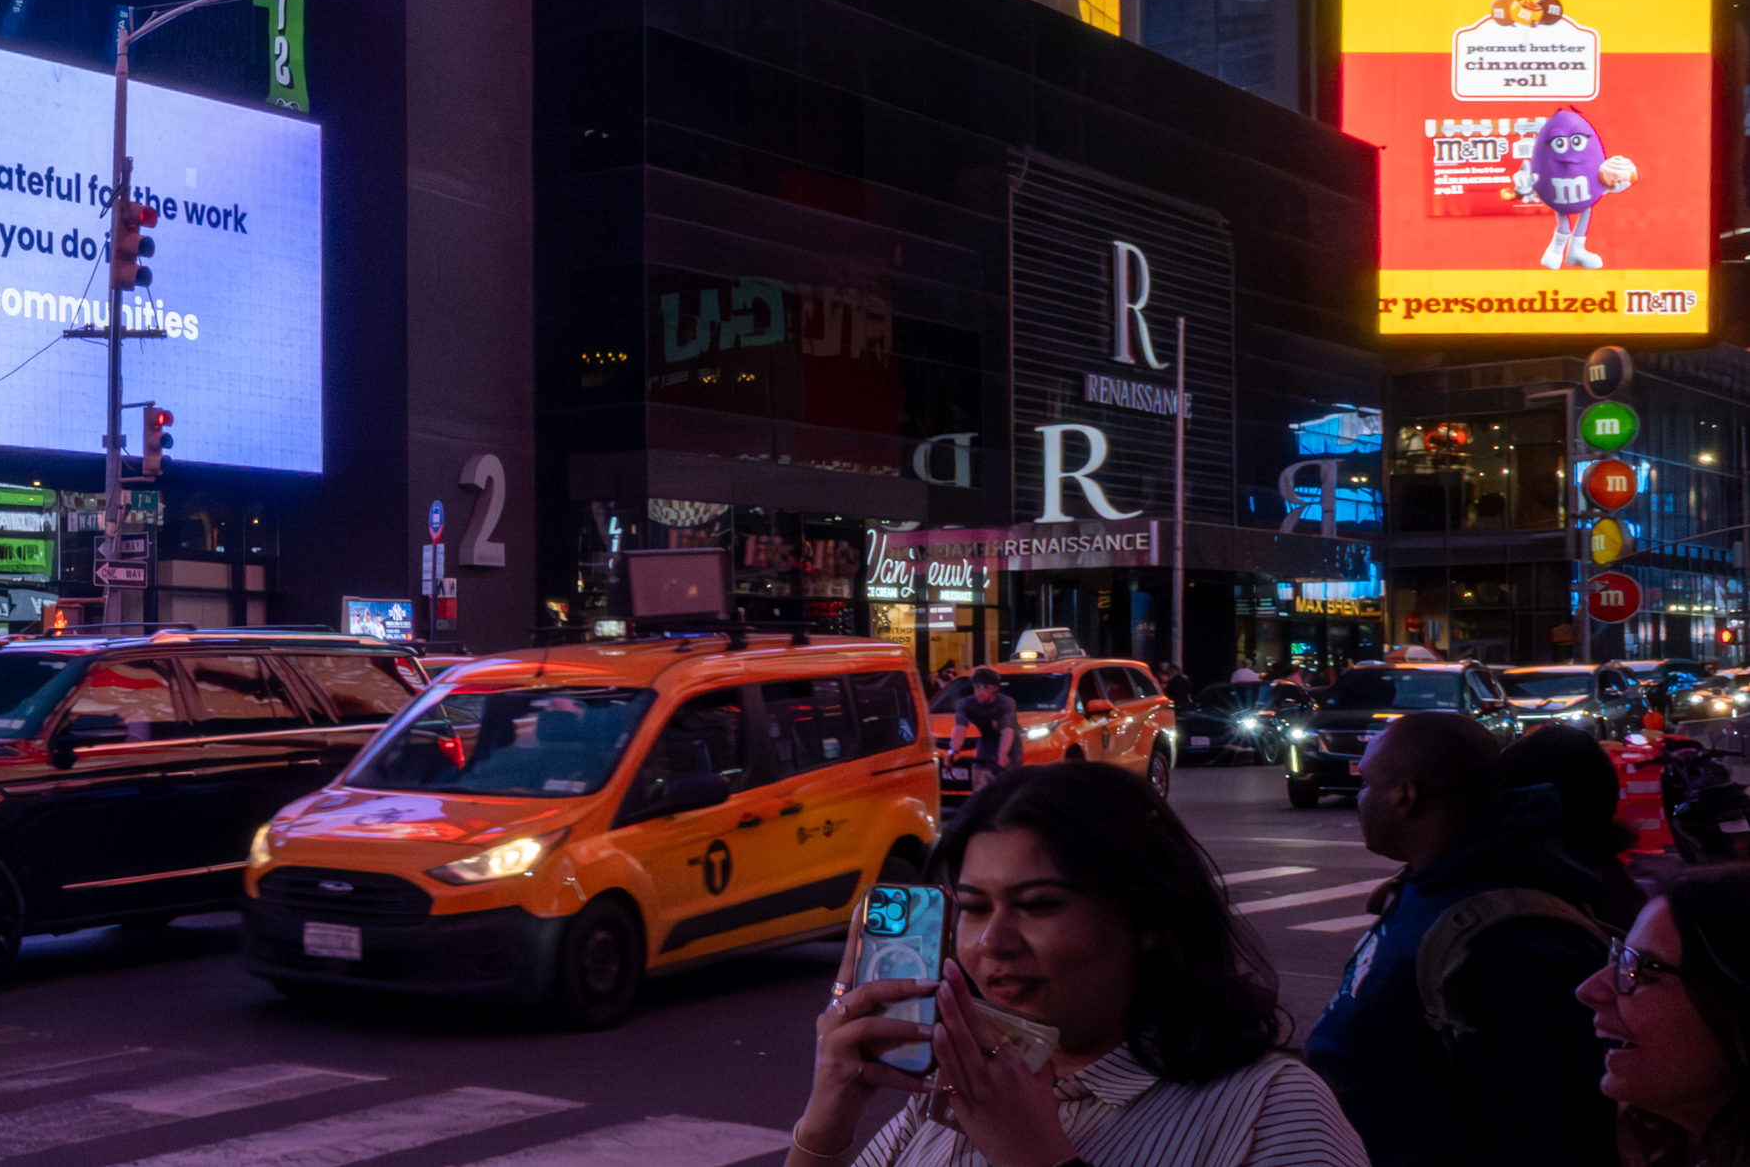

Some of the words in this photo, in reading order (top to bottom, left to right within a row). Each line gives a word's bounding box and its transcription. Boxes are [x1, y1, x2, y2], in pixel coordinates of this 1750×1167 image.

[1466, 43, 1527, 55] peanut
[1529, 43, 1585, 53] butter
[1465, 58, 1586, 71] cinnamon
[1503, 75, 1548, 87] roll
[1551, 176, 1592, 204] m
[134, 186, 178, 221] the
[184, 200, 248, 234] work
[61, 227, 97, 261] do
[1110, 240, 1170, 370] R
[1402, 290, 1617, 319] personalized
[1595, 418, 1620, 435] m
[1034, 423, 1144, 524] R
[1606, 475, 1628, 492] m
[458, 453, 507, 567] 2
[1004, 533, 1150, 557] RENAISSANCE
[125, 568, 143, 579] WAY
[1295, 596, 1324, 614] MAX
[1600, 589, 1625, 606] m
